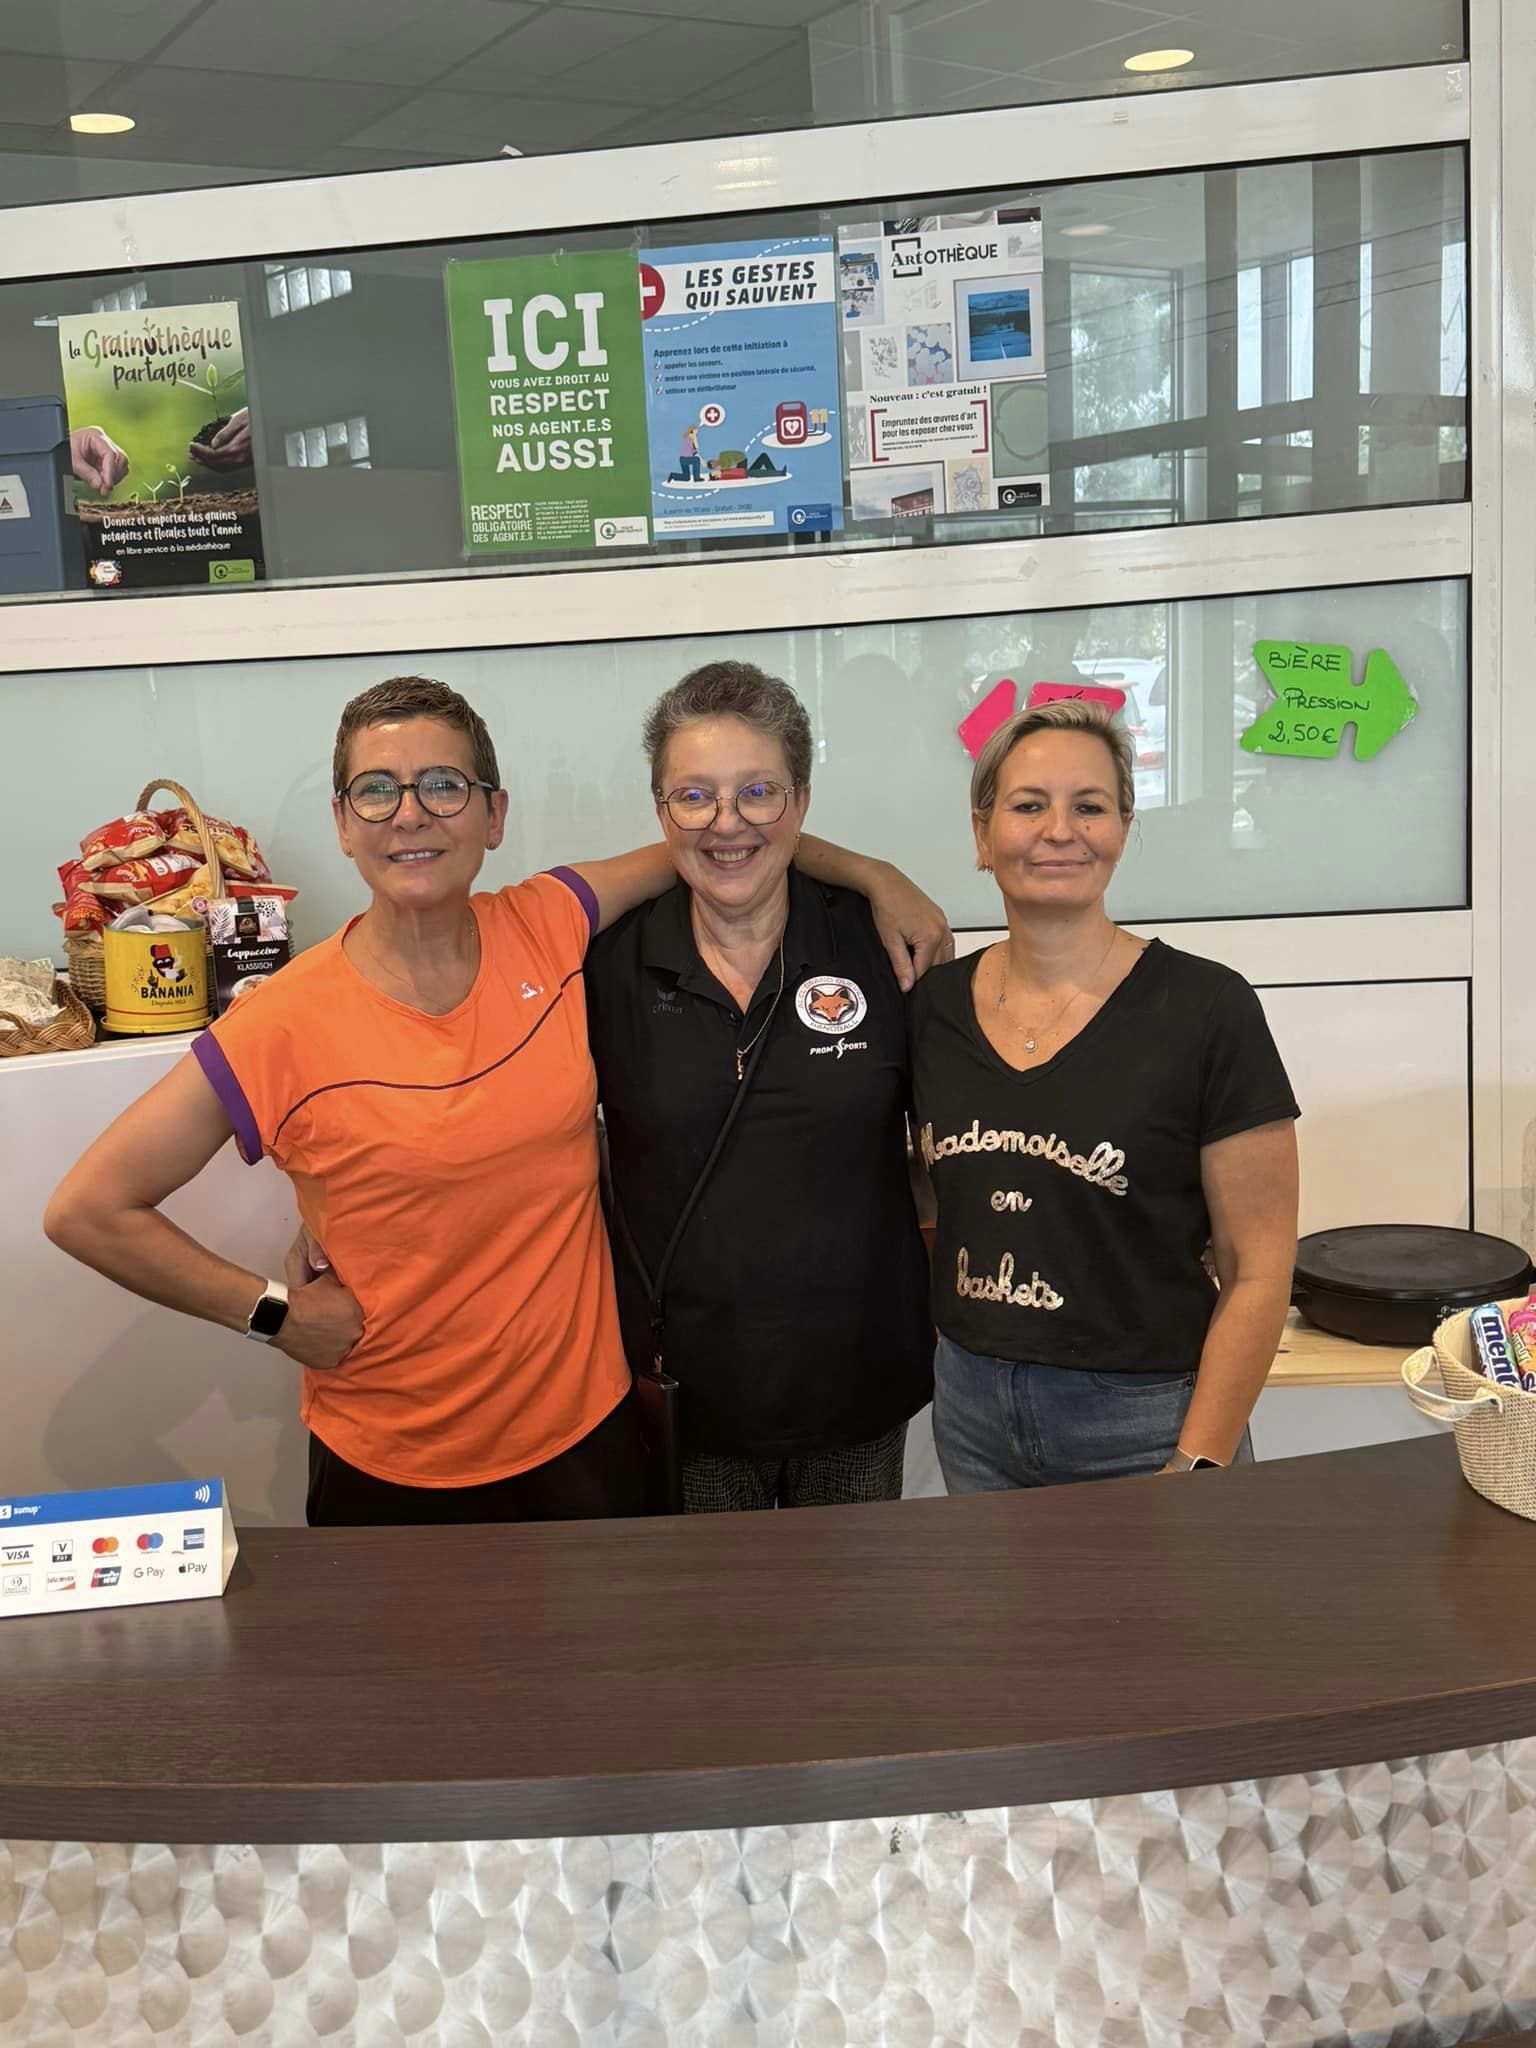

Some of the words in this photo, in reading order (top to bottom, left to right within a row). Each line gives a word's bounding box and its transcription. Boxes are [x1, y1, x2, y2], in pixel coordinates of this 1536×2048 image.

[685, 267, 723, 289] LES
[732, 260, 815, 285] GESTES
[686, 291, 720, 310] QUI
[725, 282, 817, 306] SAUVENT
[483, 292, 608, 373] ICI
[69, 340, 80, 359] la
[84, 326, 232, 368] Grainothèque
[654, 347, 691, 358] Apprenez
[694, 345, 709, 354] lors
[711, 344, 721, 353] de
[722, 343, 743, 353] cette
[744, 340, 781, 350] initiation
[113, 357, 196, 390] partagée
[490, 379, 520, 389] VOUS
[523, 376, 552, 387] AVEZ
[555, 374, 590, 385] DROIT
[593, 373, 609, 383] AU
[490, 389, 610, 416] RESPECT
[870, 394, 913, 404] Nouveau
[921, 390, 943, 399] c'est
[946, 386, 981, 398] gratuit
[492, 423, 524, 438] NOS
[528, 418, 612, 436] AGENT.E.S
[881, 417, 918, 428] Empruntez
[919, 415, 932, 424] des
[960, 411, 977, 421] d'art
[882, 429, 898, 439] pour
[899, 427, 909, 436] les
[910, 425, 938, 436] exposer
[939, 424, 956, 433] chez
[957, 423, 973, 431] vous
[496, 437, 614, 473] AUSSI
[103, 515, 136, 529] Donnez
[137, 514, 146, 526] et
[148, 512, 185, 527] emportez
[188, 511, 204, 523] des
[205, 510, 237, 524] graines
[471, 502, 531, 521] RESPECT
[101, 529, 143, 545] potagères
[144, 528, 152, 540] et
[154, 526, 187, 541] florales
[188, 525, 210, 538] toute
[211, 523, 242, 537] l'année
[472, 520, 533, 533] OBLIGATOIRE
[473, 533, 489, 543] DES
[493, 531, 534, 542] AGENT.E.S
[127, 546, 142, 555] libre
[143, 546, 168, 554] service
[177, 543, 185, 552] la
[186, 541, 231, 553] médiathèque
[227, 947, 280, 960] Cappuccino
[237, 962, 272, 971] KLASSISCH
[141, 984, 194, 999] BANANIA
[990, 1190, 1032, 1212] en
[957, 1247, 1064, 1310] baskets
[1481, 1317, 1521, 1389] ment
[7, 1550, 30, 1560] VISA
[59, 1543, 67, 1552] V
[146, 1566, 165, 1579] Pay
[187, 1563, 207, 1574] Pay
